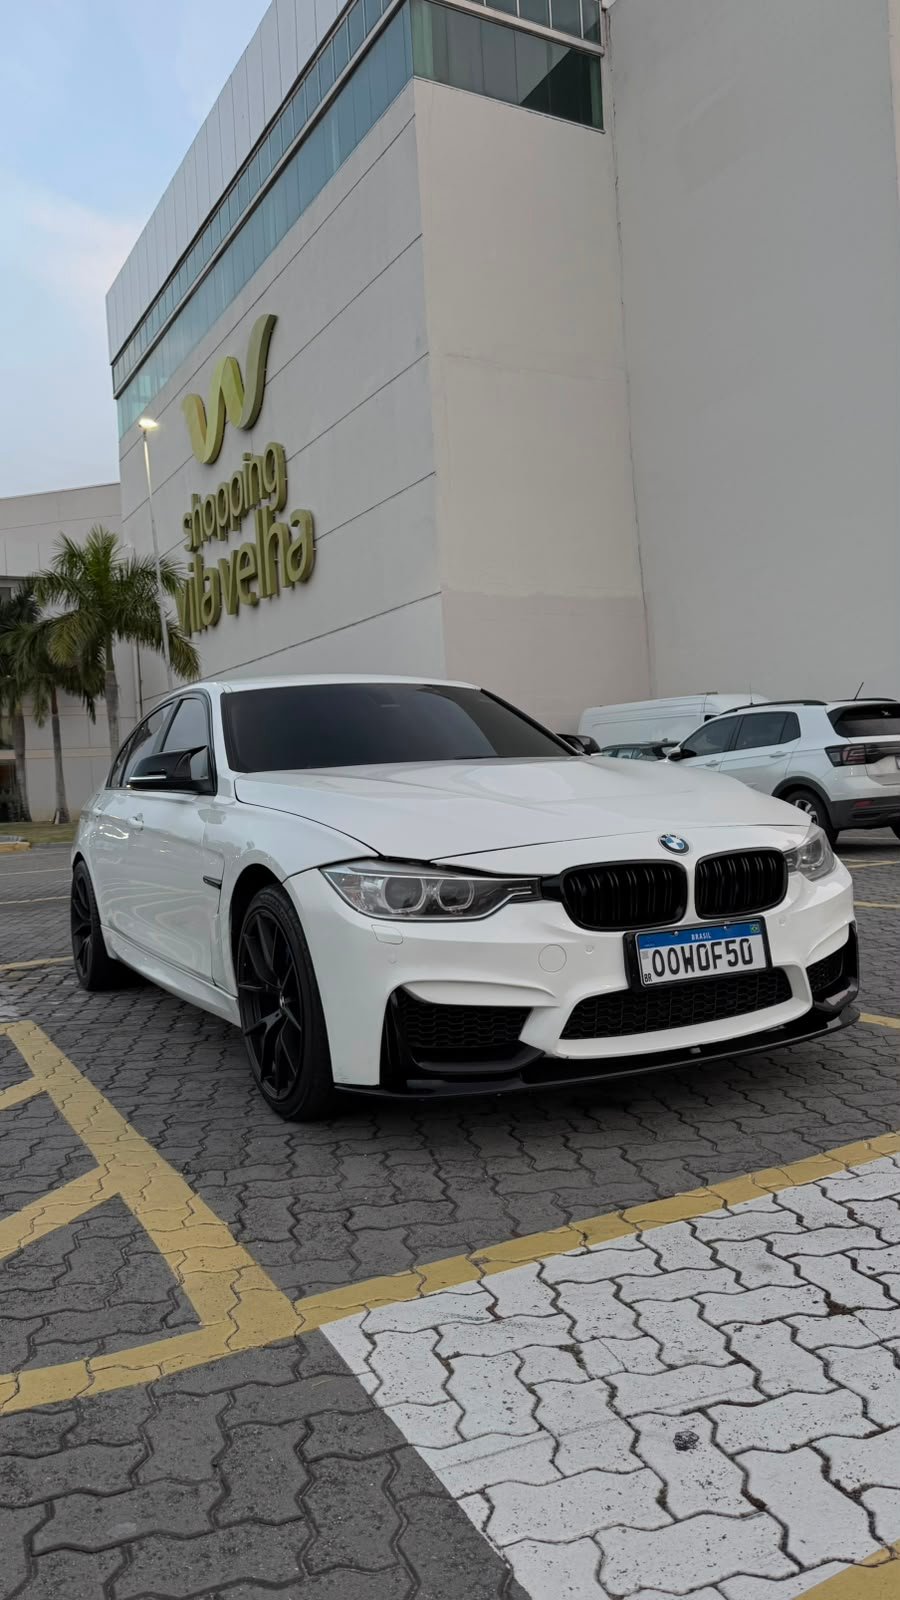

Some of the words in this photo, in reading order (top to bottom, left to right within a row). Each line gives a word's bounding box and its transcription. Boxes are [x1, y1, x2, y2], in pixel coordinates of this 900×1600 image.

[182, 442, 287, 551] shopping
[175, 506, 314, 637] vilavelha
[691, 932, 712, 941] BRASIL
[644, 973, 653, 983] BR
